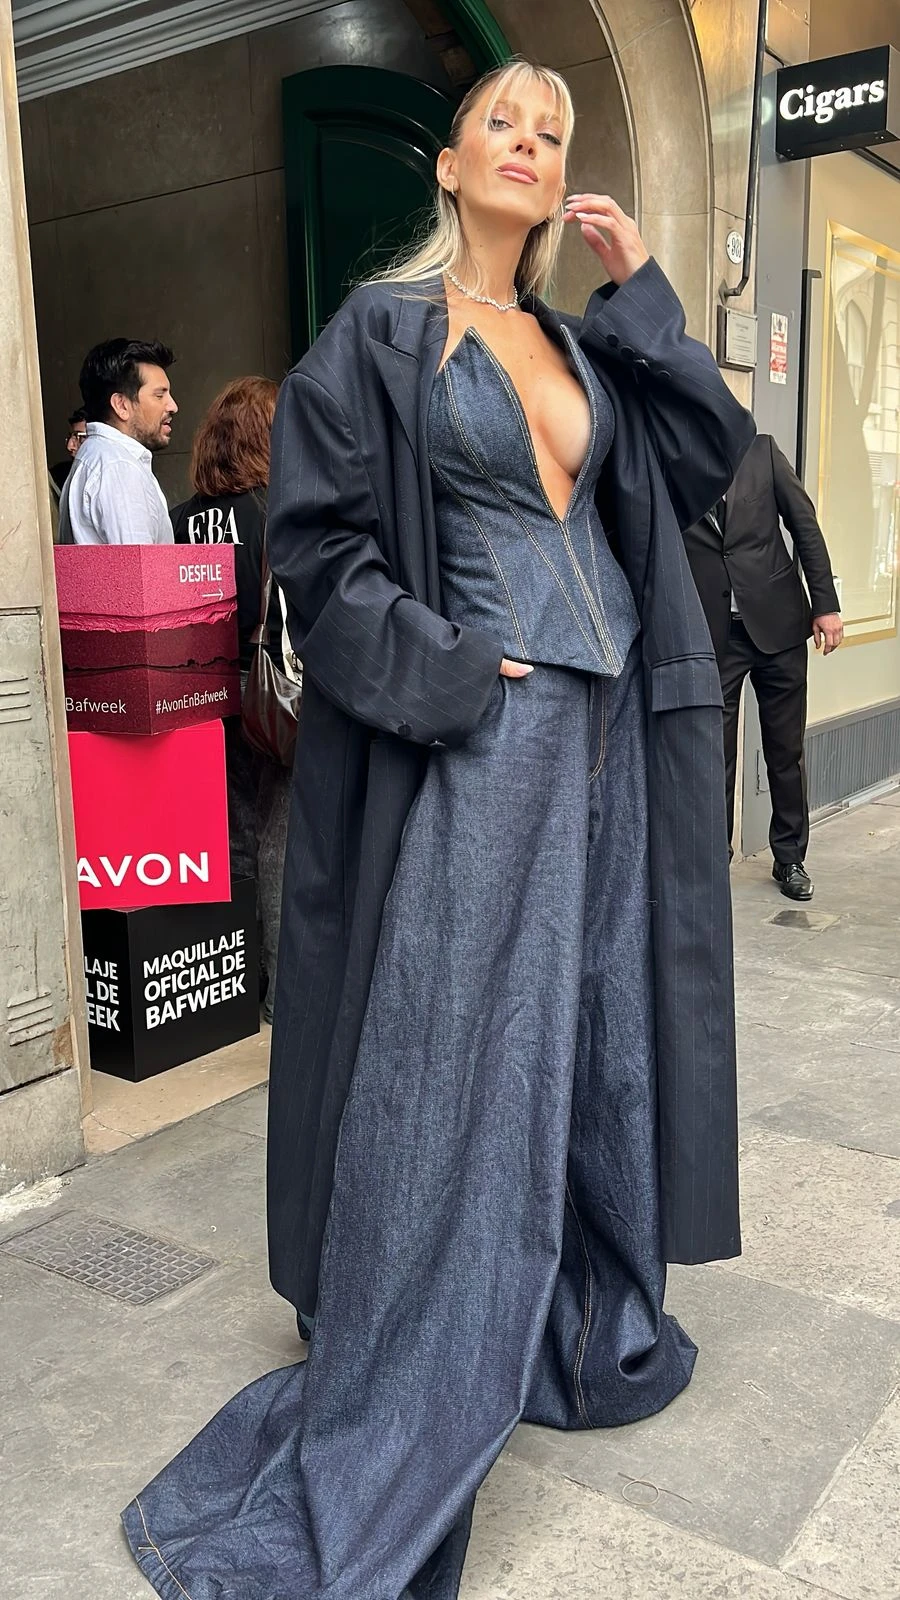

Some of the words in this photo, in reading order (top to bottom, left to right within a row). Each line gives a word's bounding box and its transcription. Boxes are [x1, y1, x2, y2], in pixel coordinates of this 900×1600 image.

[780, 80, 885, 124] Cigars
[187, 506, 244, 545] EBA
[179, 564, 222, 583] DESFILE
[65, 697, 127, 714] Bafweek
[155, 686, 228, 715] #AvonEnBafweek
[76, 851, 209, 888] AVON
[143, 928, 245, 979] MAQUILLAJE
[96, 980, 120, 1005] DE
[144, 960, 220, 1002] OFICIAL
[221, 949, 246, 975] DE
[145, 972, 247, 1030] BAFWEEK
